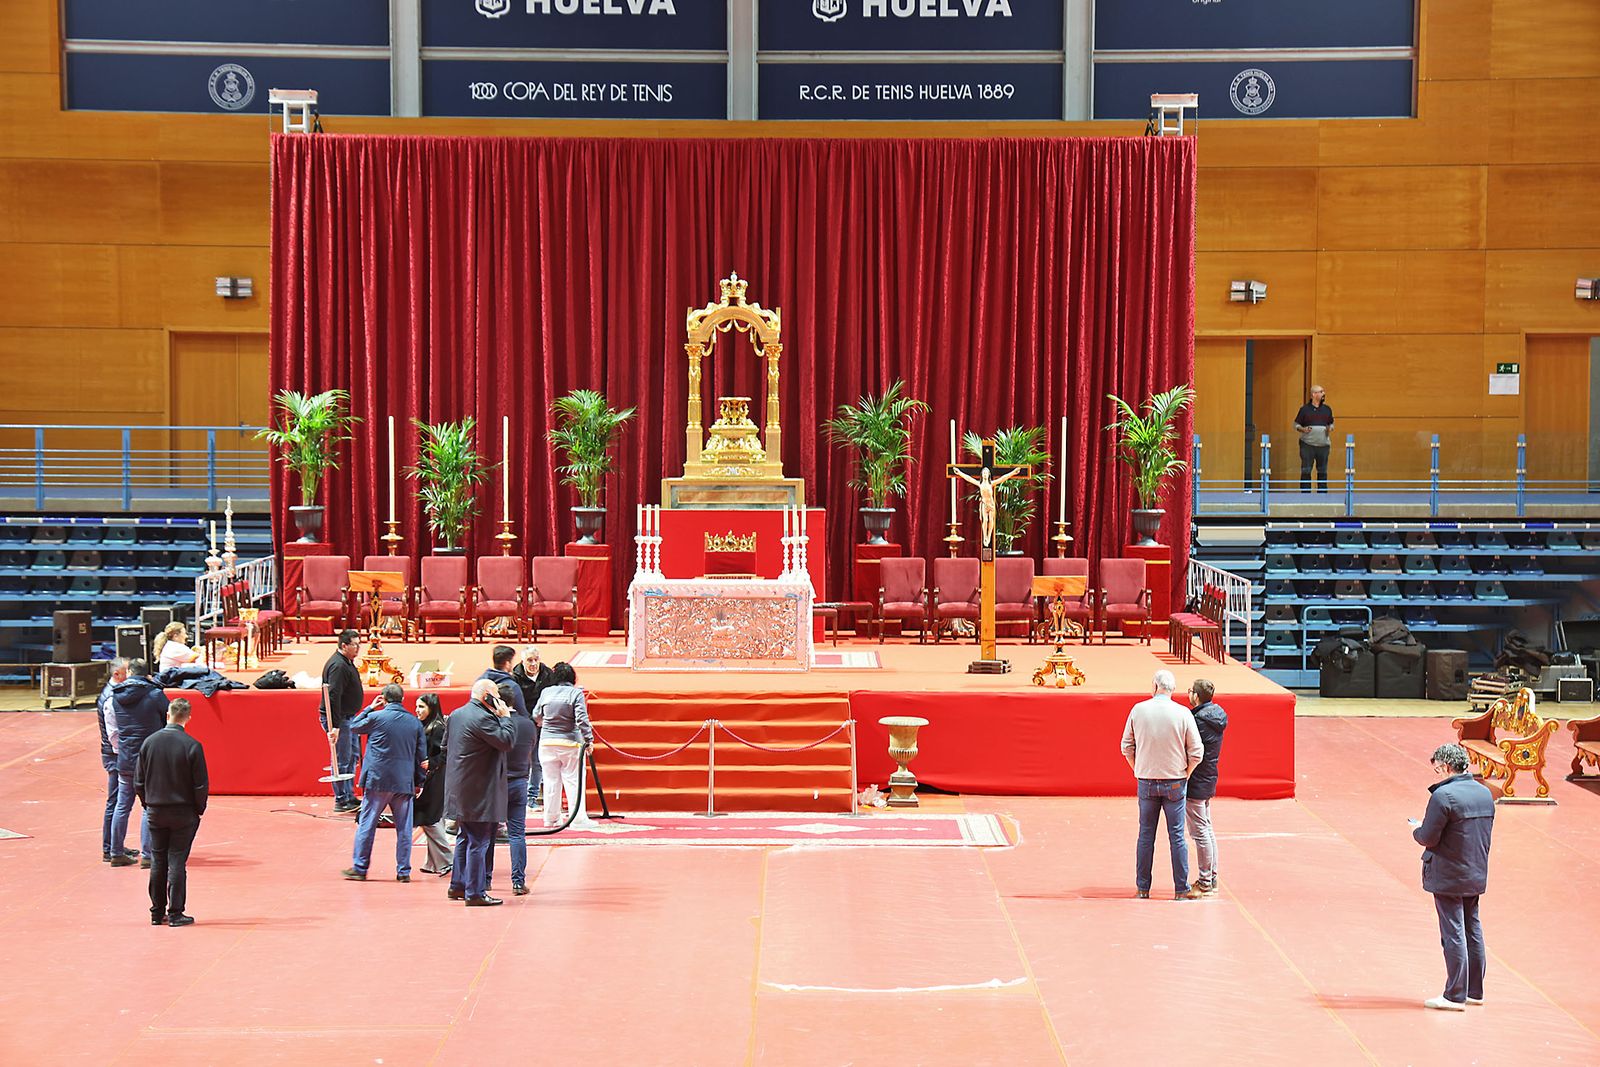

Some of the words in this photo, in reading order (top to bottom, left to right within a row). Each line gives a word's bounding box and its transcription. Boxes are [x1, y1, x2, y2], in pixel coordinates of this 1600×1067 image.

[525, 0, 677, 15] HUELVA
[862, 0, 1013, 18] HUELVA
[502, 82, 550, 101] COPA
[553, 83, 578, 101] DEL
[581, 84, 607, 102] REY
[610, 84, 628, 102] DE
[631, 84, 673, 103] TENIS
[799, 84, 847, 101] R.C.R.
[852, 84, 870, 100] DE
[874, 84, 914, 100] TENIS
[919, 84, 973, 100] HUELVA
[977, 83, 1015, 100] 1889
